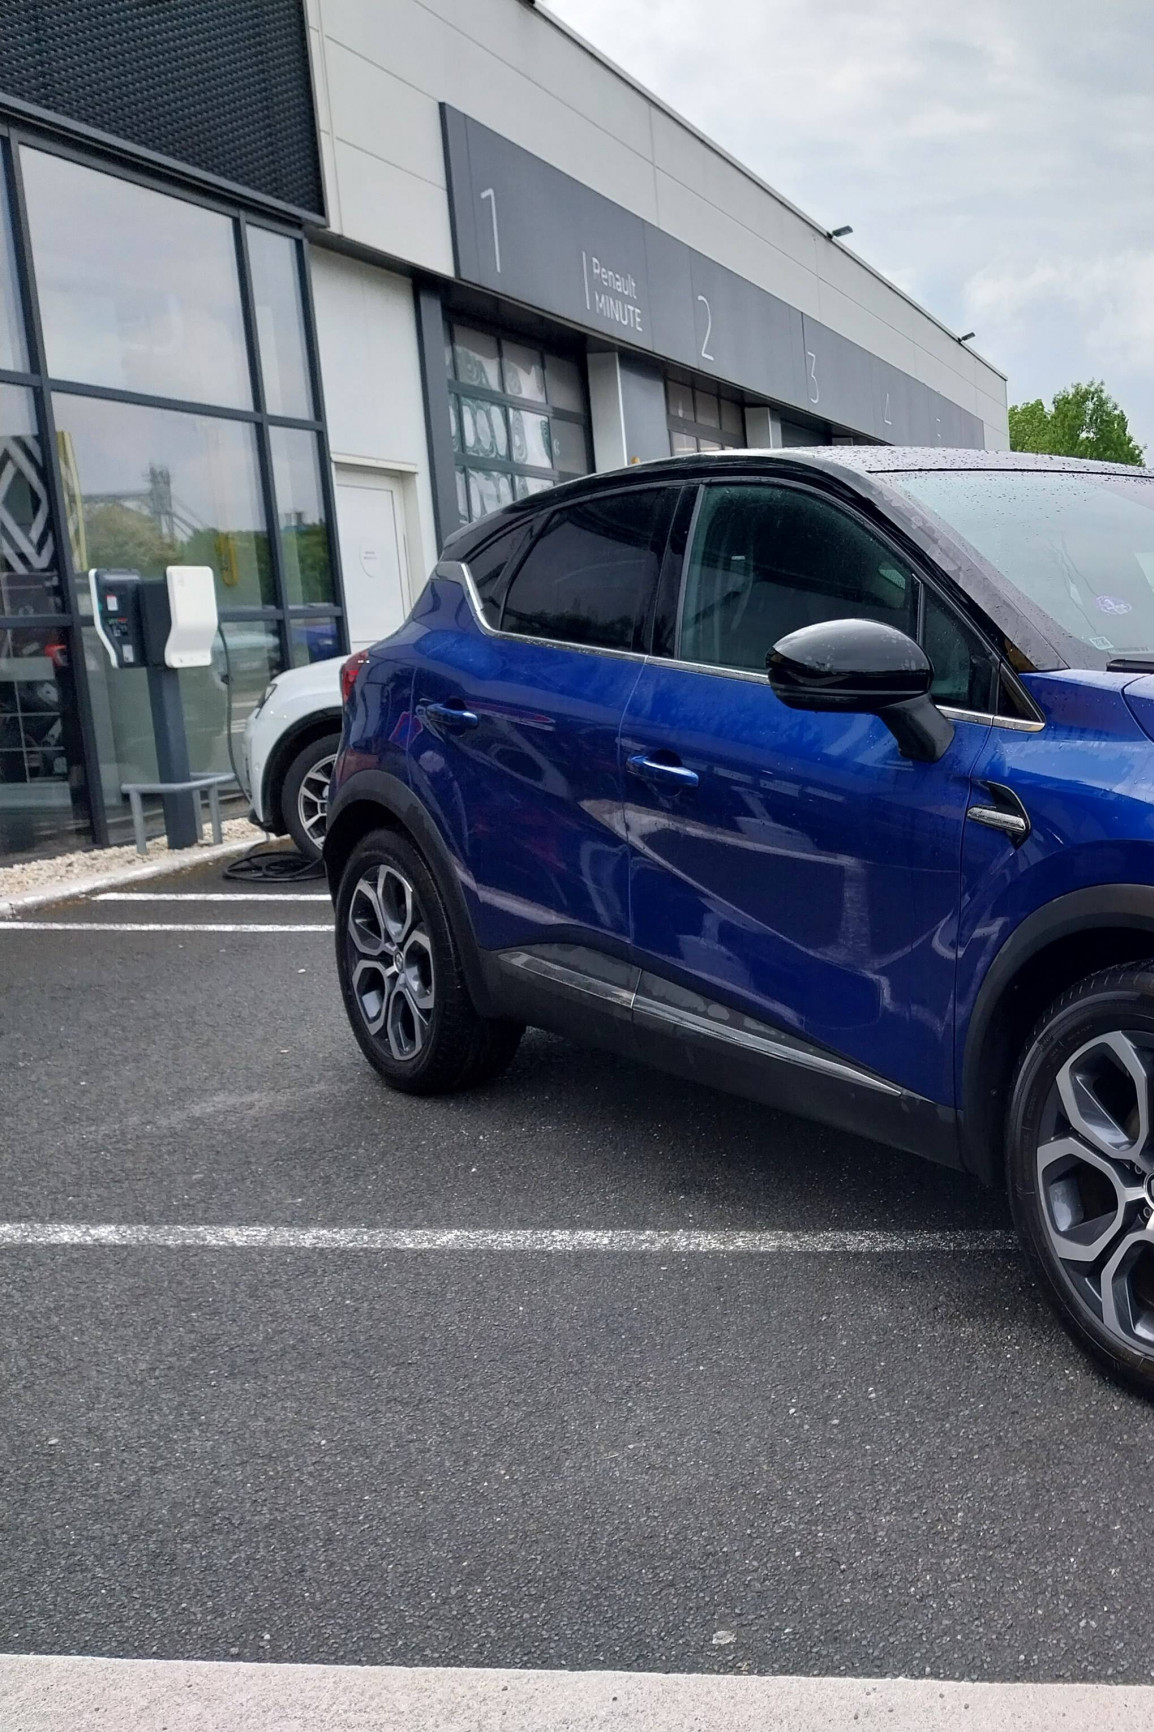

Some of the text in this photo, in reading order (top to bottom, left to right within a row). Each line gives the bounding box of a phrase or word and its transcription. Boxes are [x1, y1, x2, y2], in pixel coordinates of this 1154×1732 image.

[481, 187, 501, 274] 1
[592, 256, 637, 299] Renault
[594, 291, 643, 332] MINUTE
[698, 295, 714, 361] 2
[807, 351, 819, 404] 3
